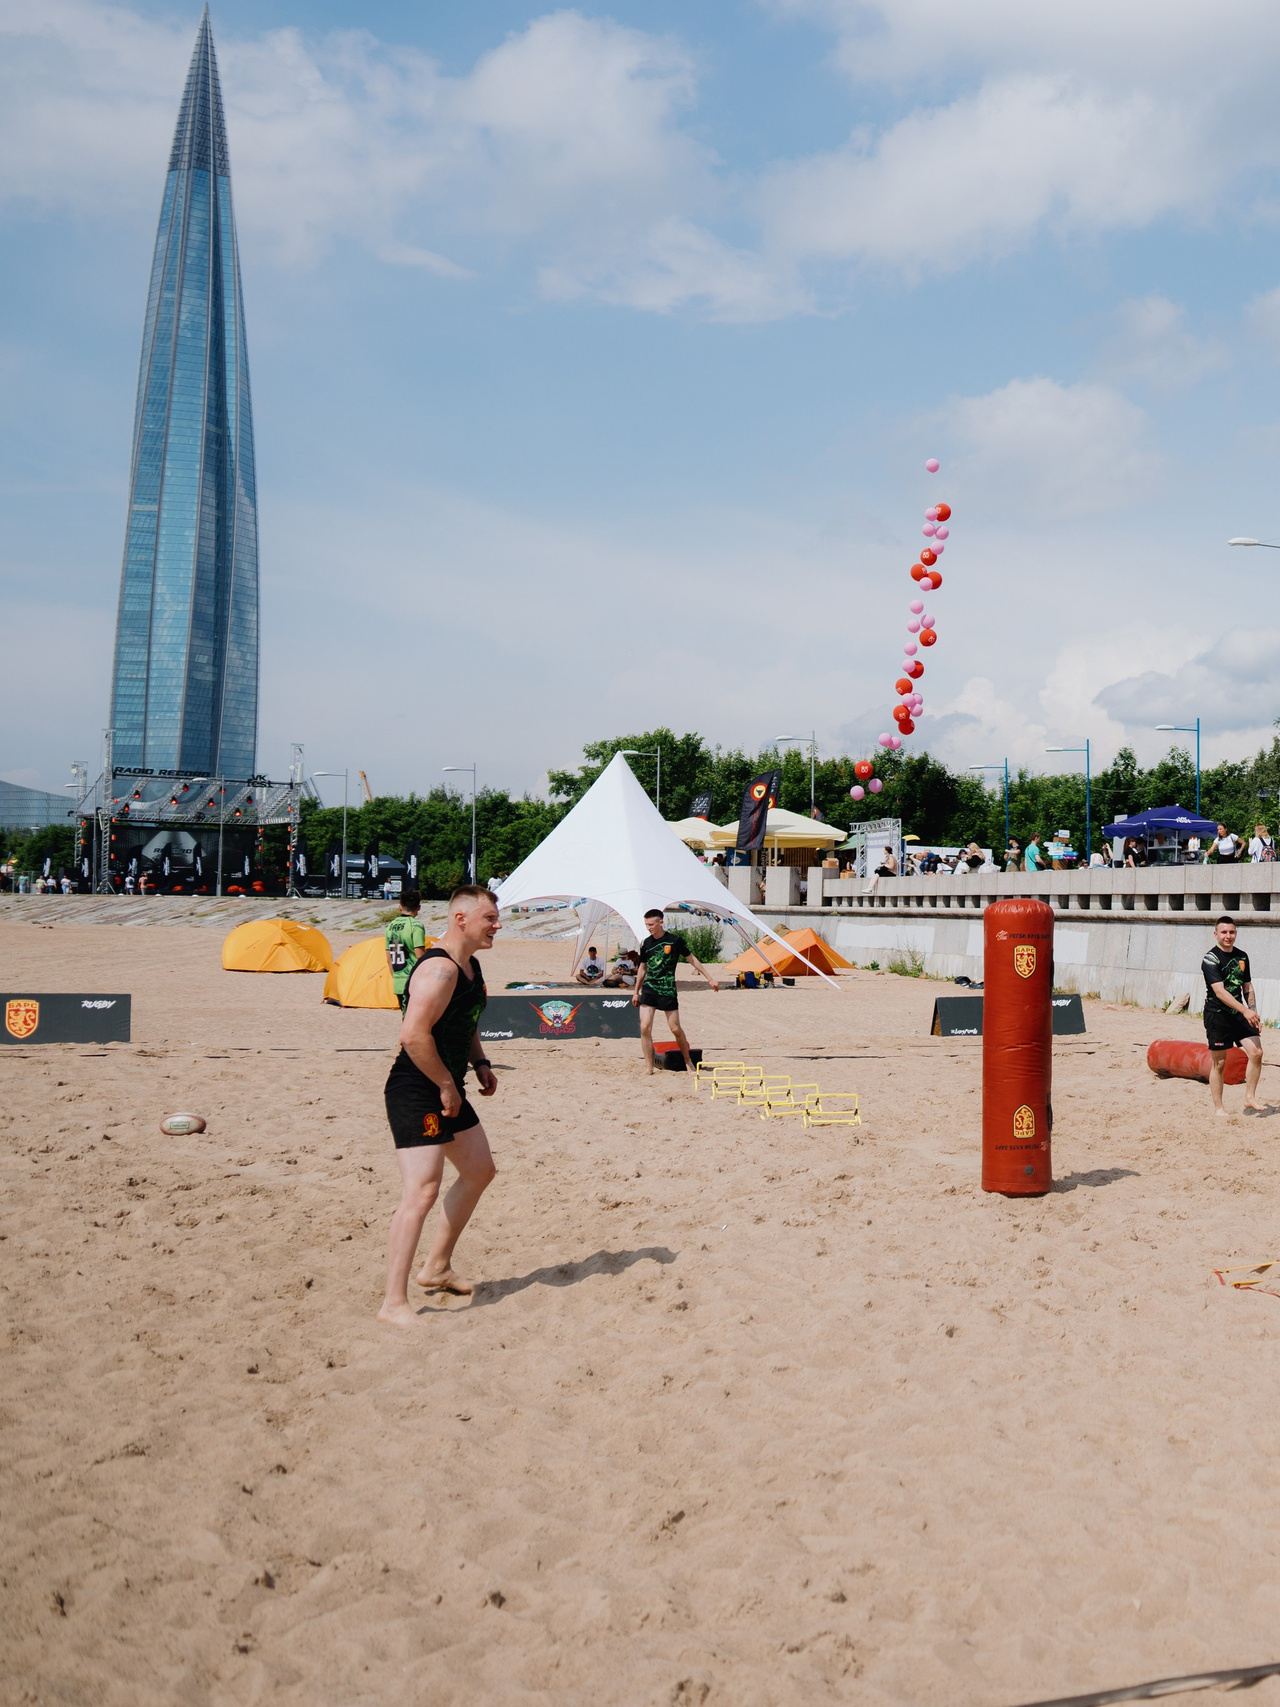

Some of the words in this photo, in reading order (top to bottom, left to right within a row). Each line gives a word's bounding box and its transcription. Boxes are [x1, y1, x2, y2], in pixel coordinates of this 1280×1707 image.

[114, 766, 154, 775] RADIO
[158, 769, 211, 778] RECORD
[860, 765, 869, 774] 85
[389, 943, 405, 965] 55
[81, 1000, 116, 1009] RUGBY
[602, 1000, 629, 1008] RUGBY
